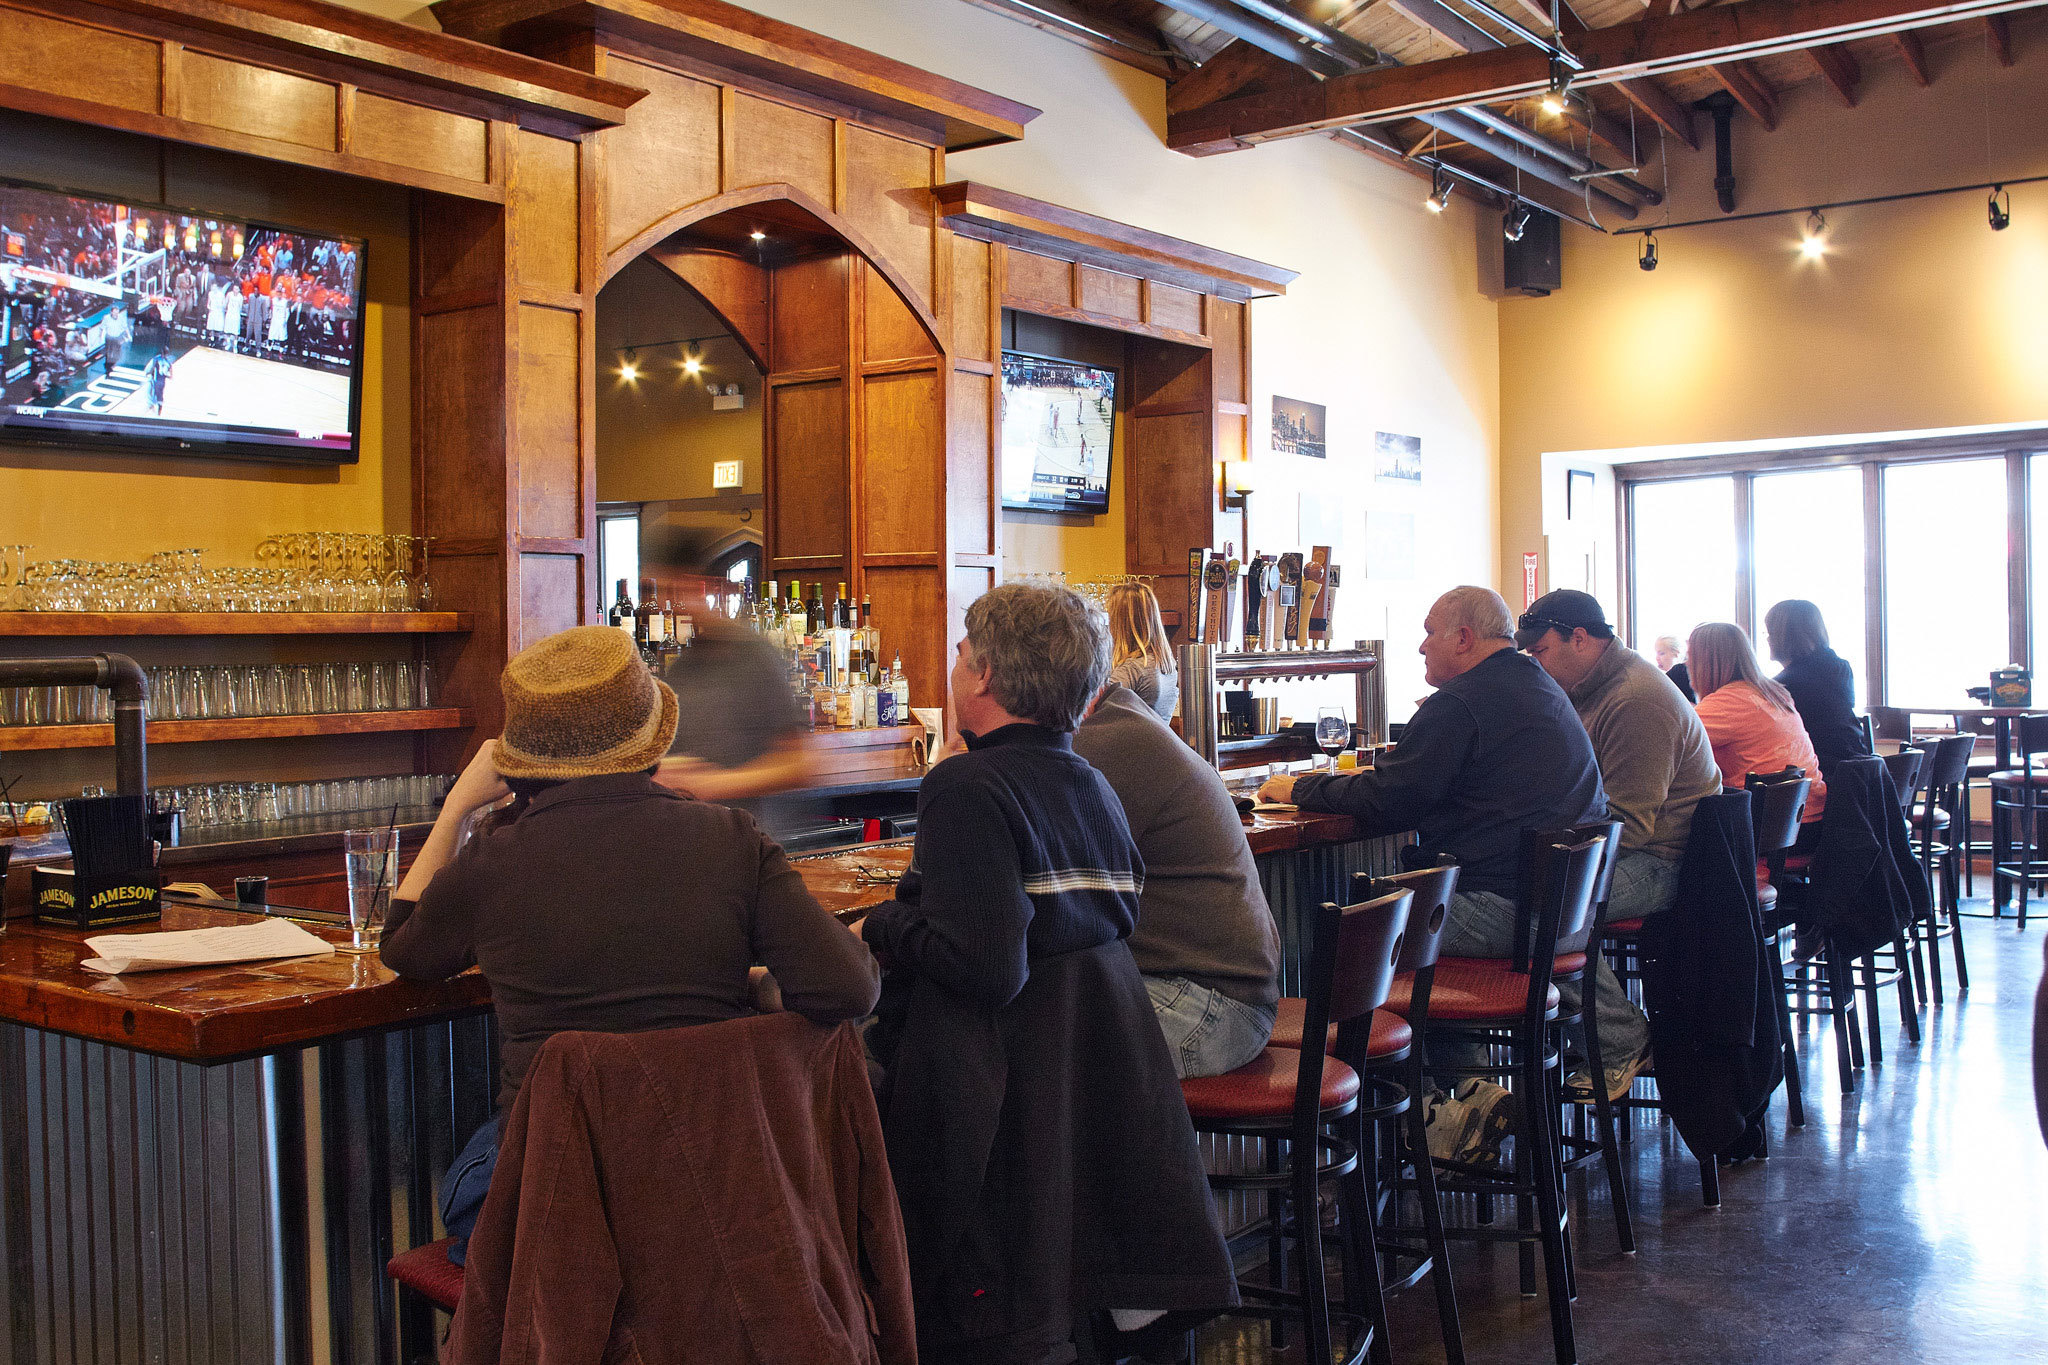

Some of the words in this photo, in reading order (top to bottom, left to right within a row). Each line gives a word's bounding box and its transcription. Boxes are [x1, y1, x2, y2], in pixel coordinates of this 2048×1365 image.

[1525, 558, 1536, 566] FIRE
[40, 888, 75, 908] JAMESON
[90, 886, 155, 909] JAMESON
